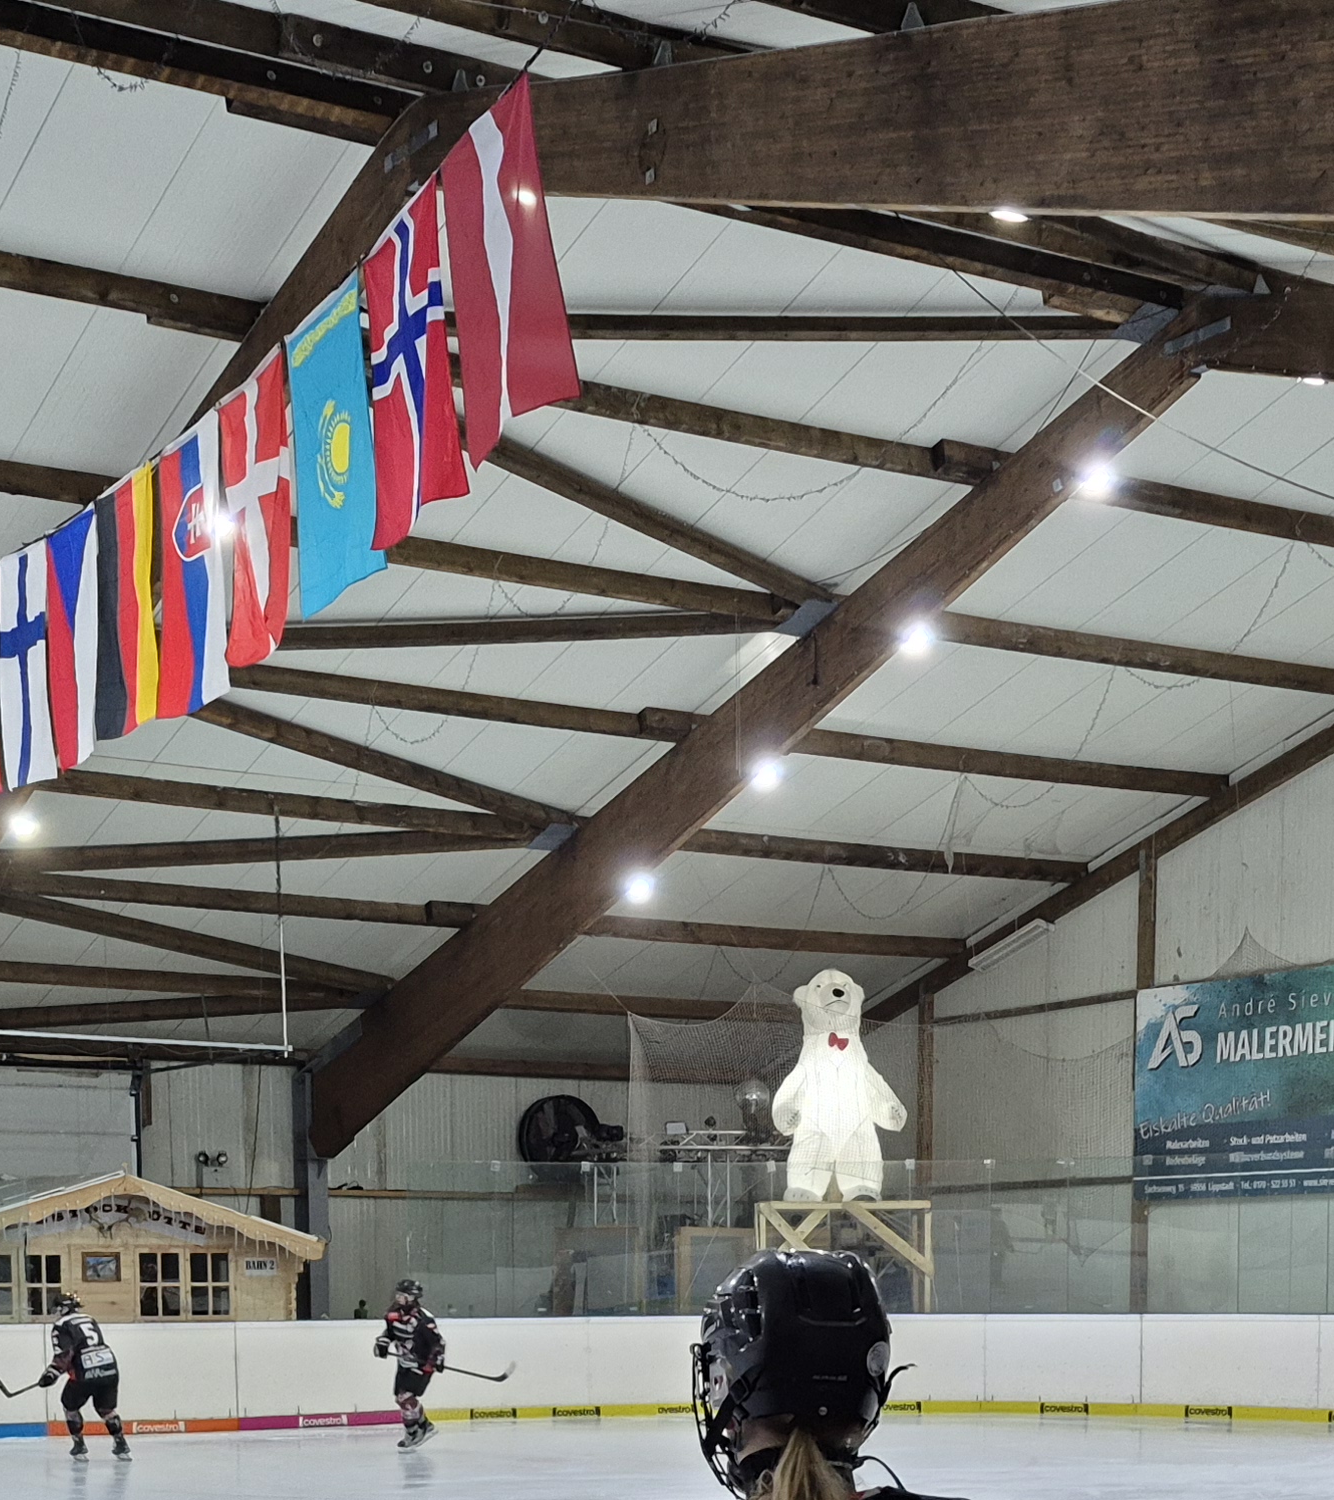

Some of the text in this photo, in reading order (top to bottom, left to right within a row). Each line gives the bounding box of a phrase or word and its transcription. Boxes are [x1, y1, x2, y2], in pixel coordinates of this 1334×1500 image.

[1218, 995, 1276, 1020] André
[1139, 1090, 1272, 1140] Eiskalte Qualität!
[245, 1258, 276, 1271] BAHN 2
[79, 1322, 99, 1346] 5
[472, 1408, 513, 1420] covestro
[555, 1407, 596, 1419] covestro
[1044, 1403, 1084, 1415] covestro
[1188, 1405, 1228, 1417] covestro
[136, 1421, 181, 1434] covestro
[303, 1416, 343, 1428] covestro
